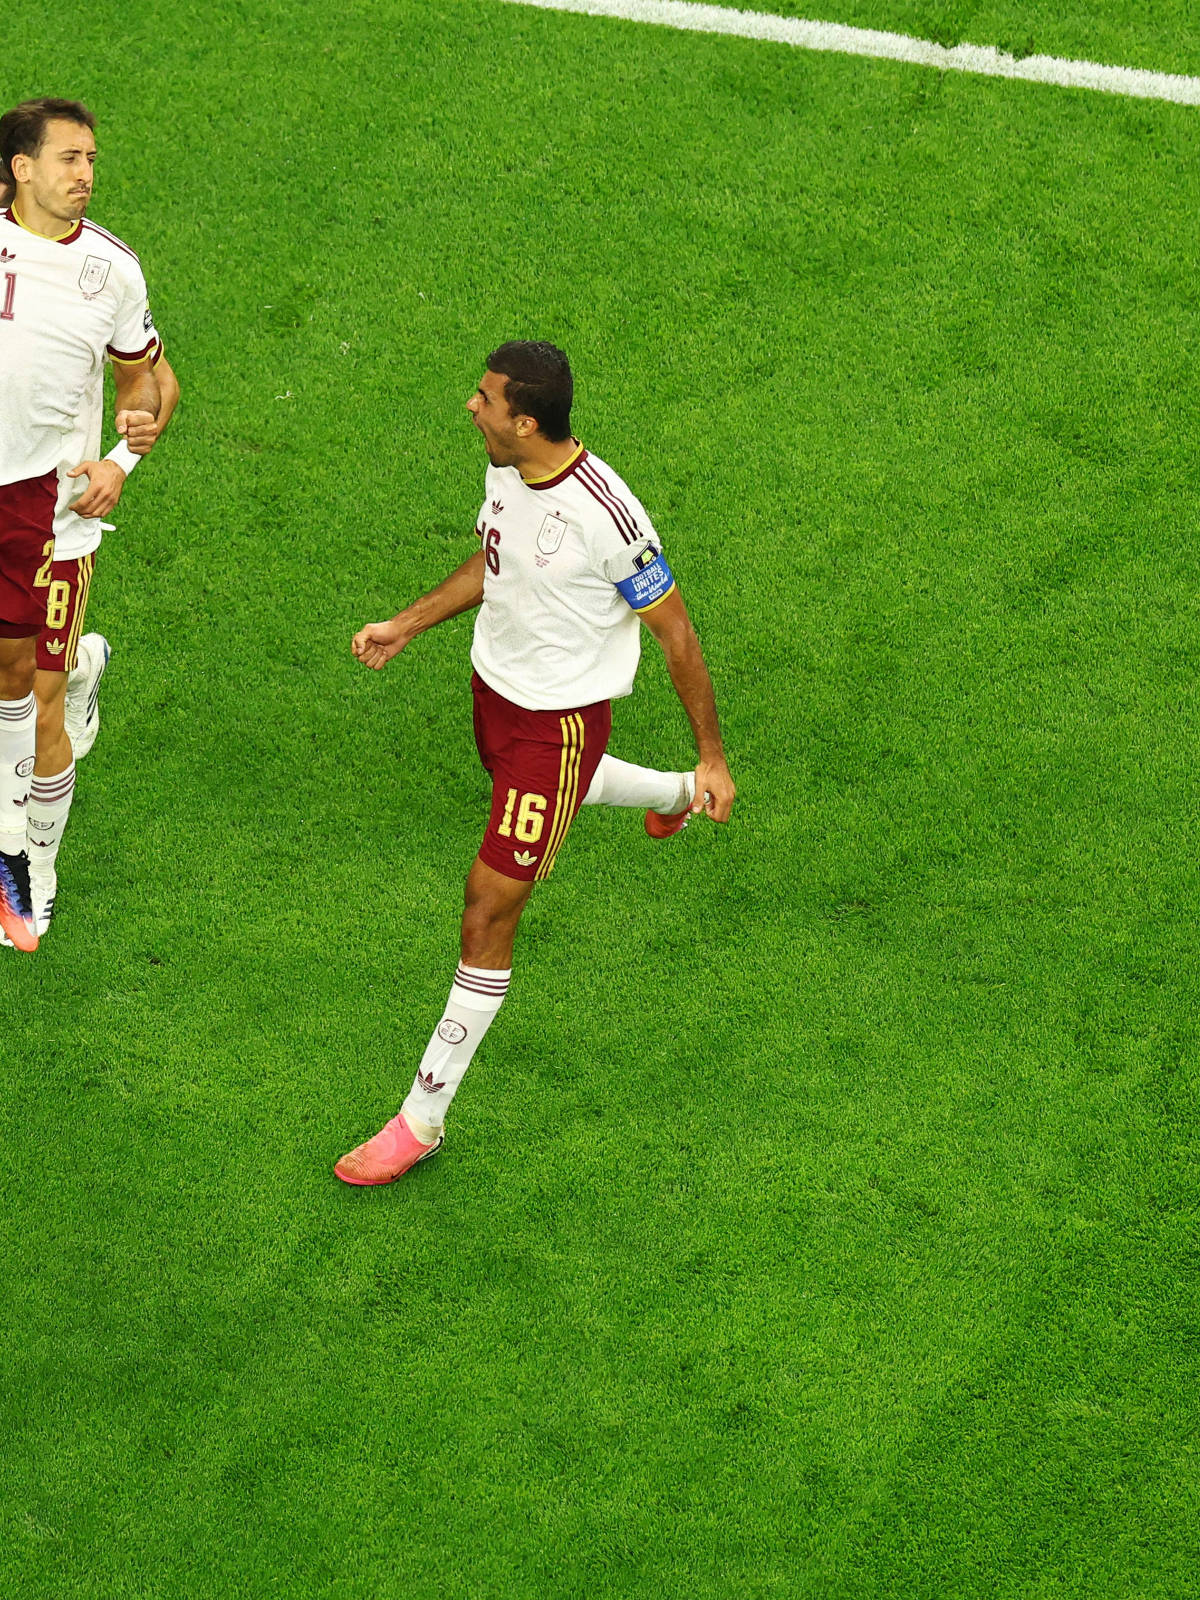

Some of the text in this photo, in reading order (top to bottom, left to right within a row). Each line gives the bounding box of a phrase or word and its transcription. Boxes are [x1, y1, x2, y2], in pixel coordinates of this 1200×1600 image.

[631, 562, 661, 584] FOOTBALL
[633, 567, 664, 592] UNITES
[46, 580, 70, 629] 8
[497, 788, 547, 843] 16
